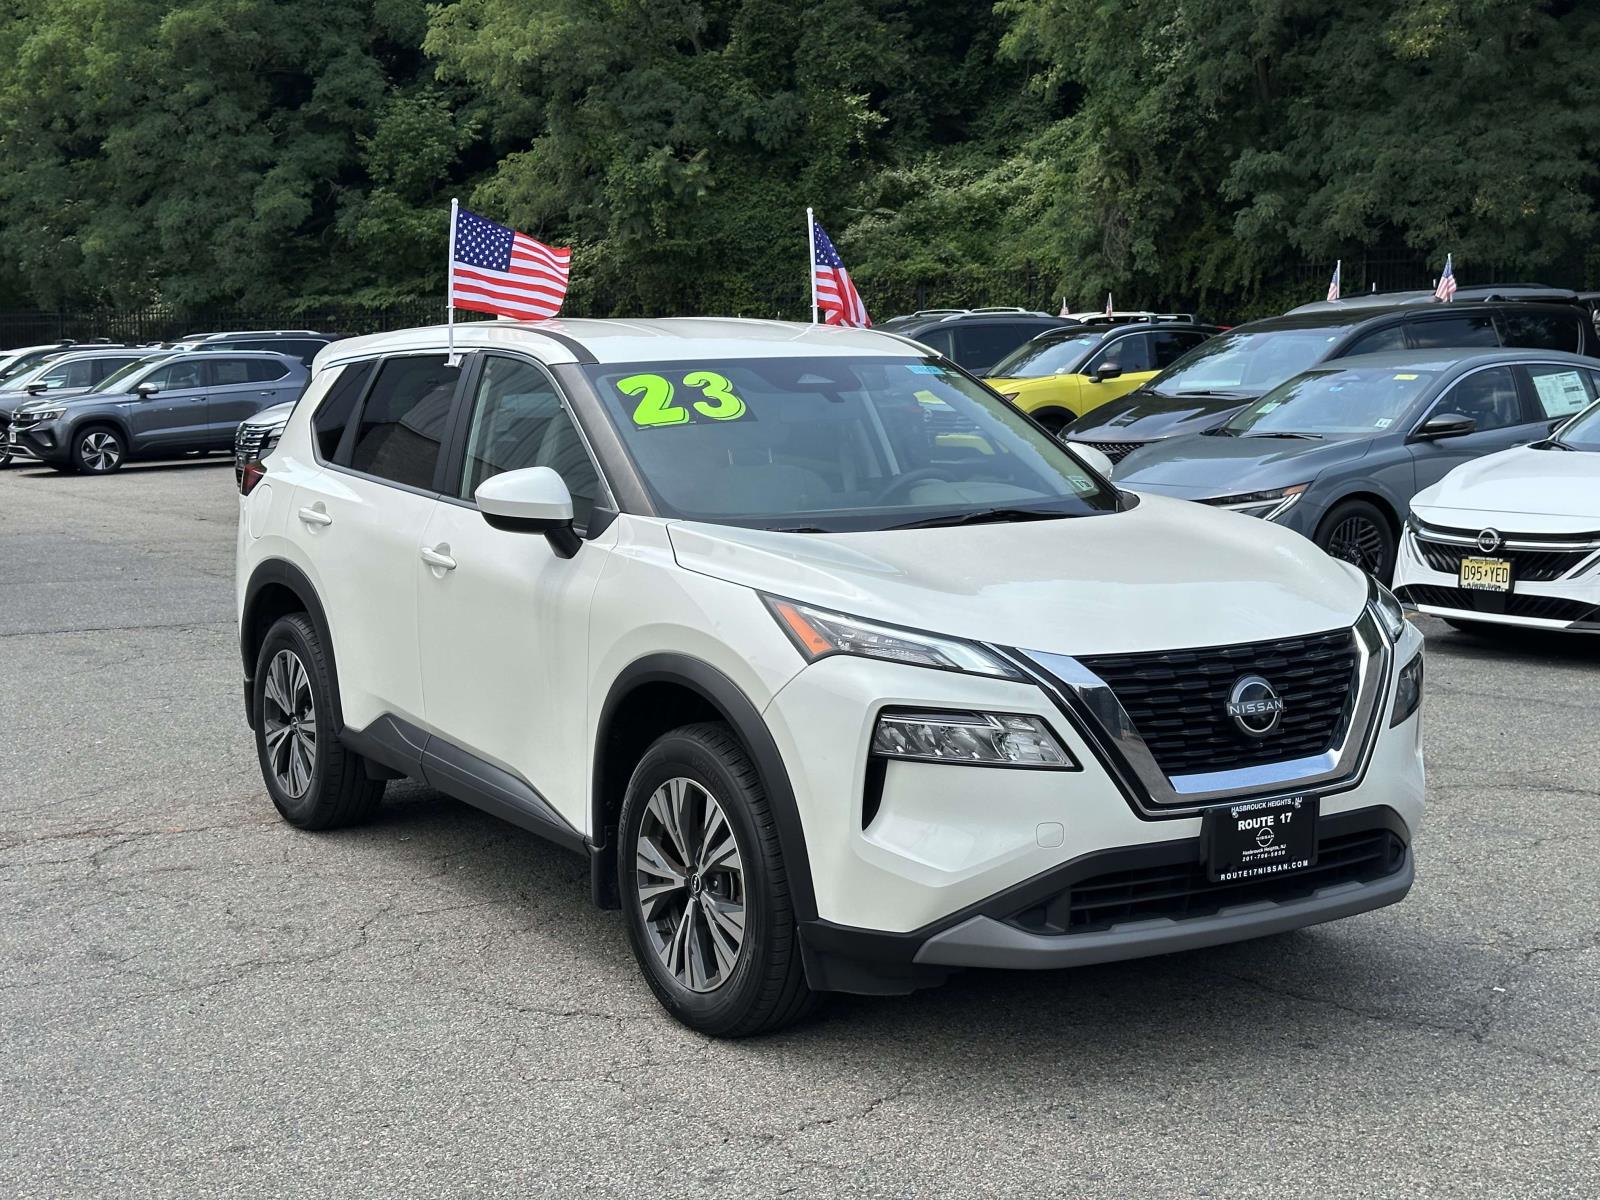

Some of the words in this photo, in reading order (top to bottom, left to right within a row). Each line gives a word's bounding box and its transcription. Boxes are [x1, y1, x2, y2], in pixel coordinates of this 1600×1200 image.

[616, 371, 746, 427] 23
[1229, 700, 1282, 714] NISSAN
[1231, 802, 1267, 812] HASBROUCK
[1238, 816, 1274, 831] ROUTE
[1280, 812, 1292, 824] 17
[1220, 860, 1309, 880] ROUTE17NISSAN.COM
